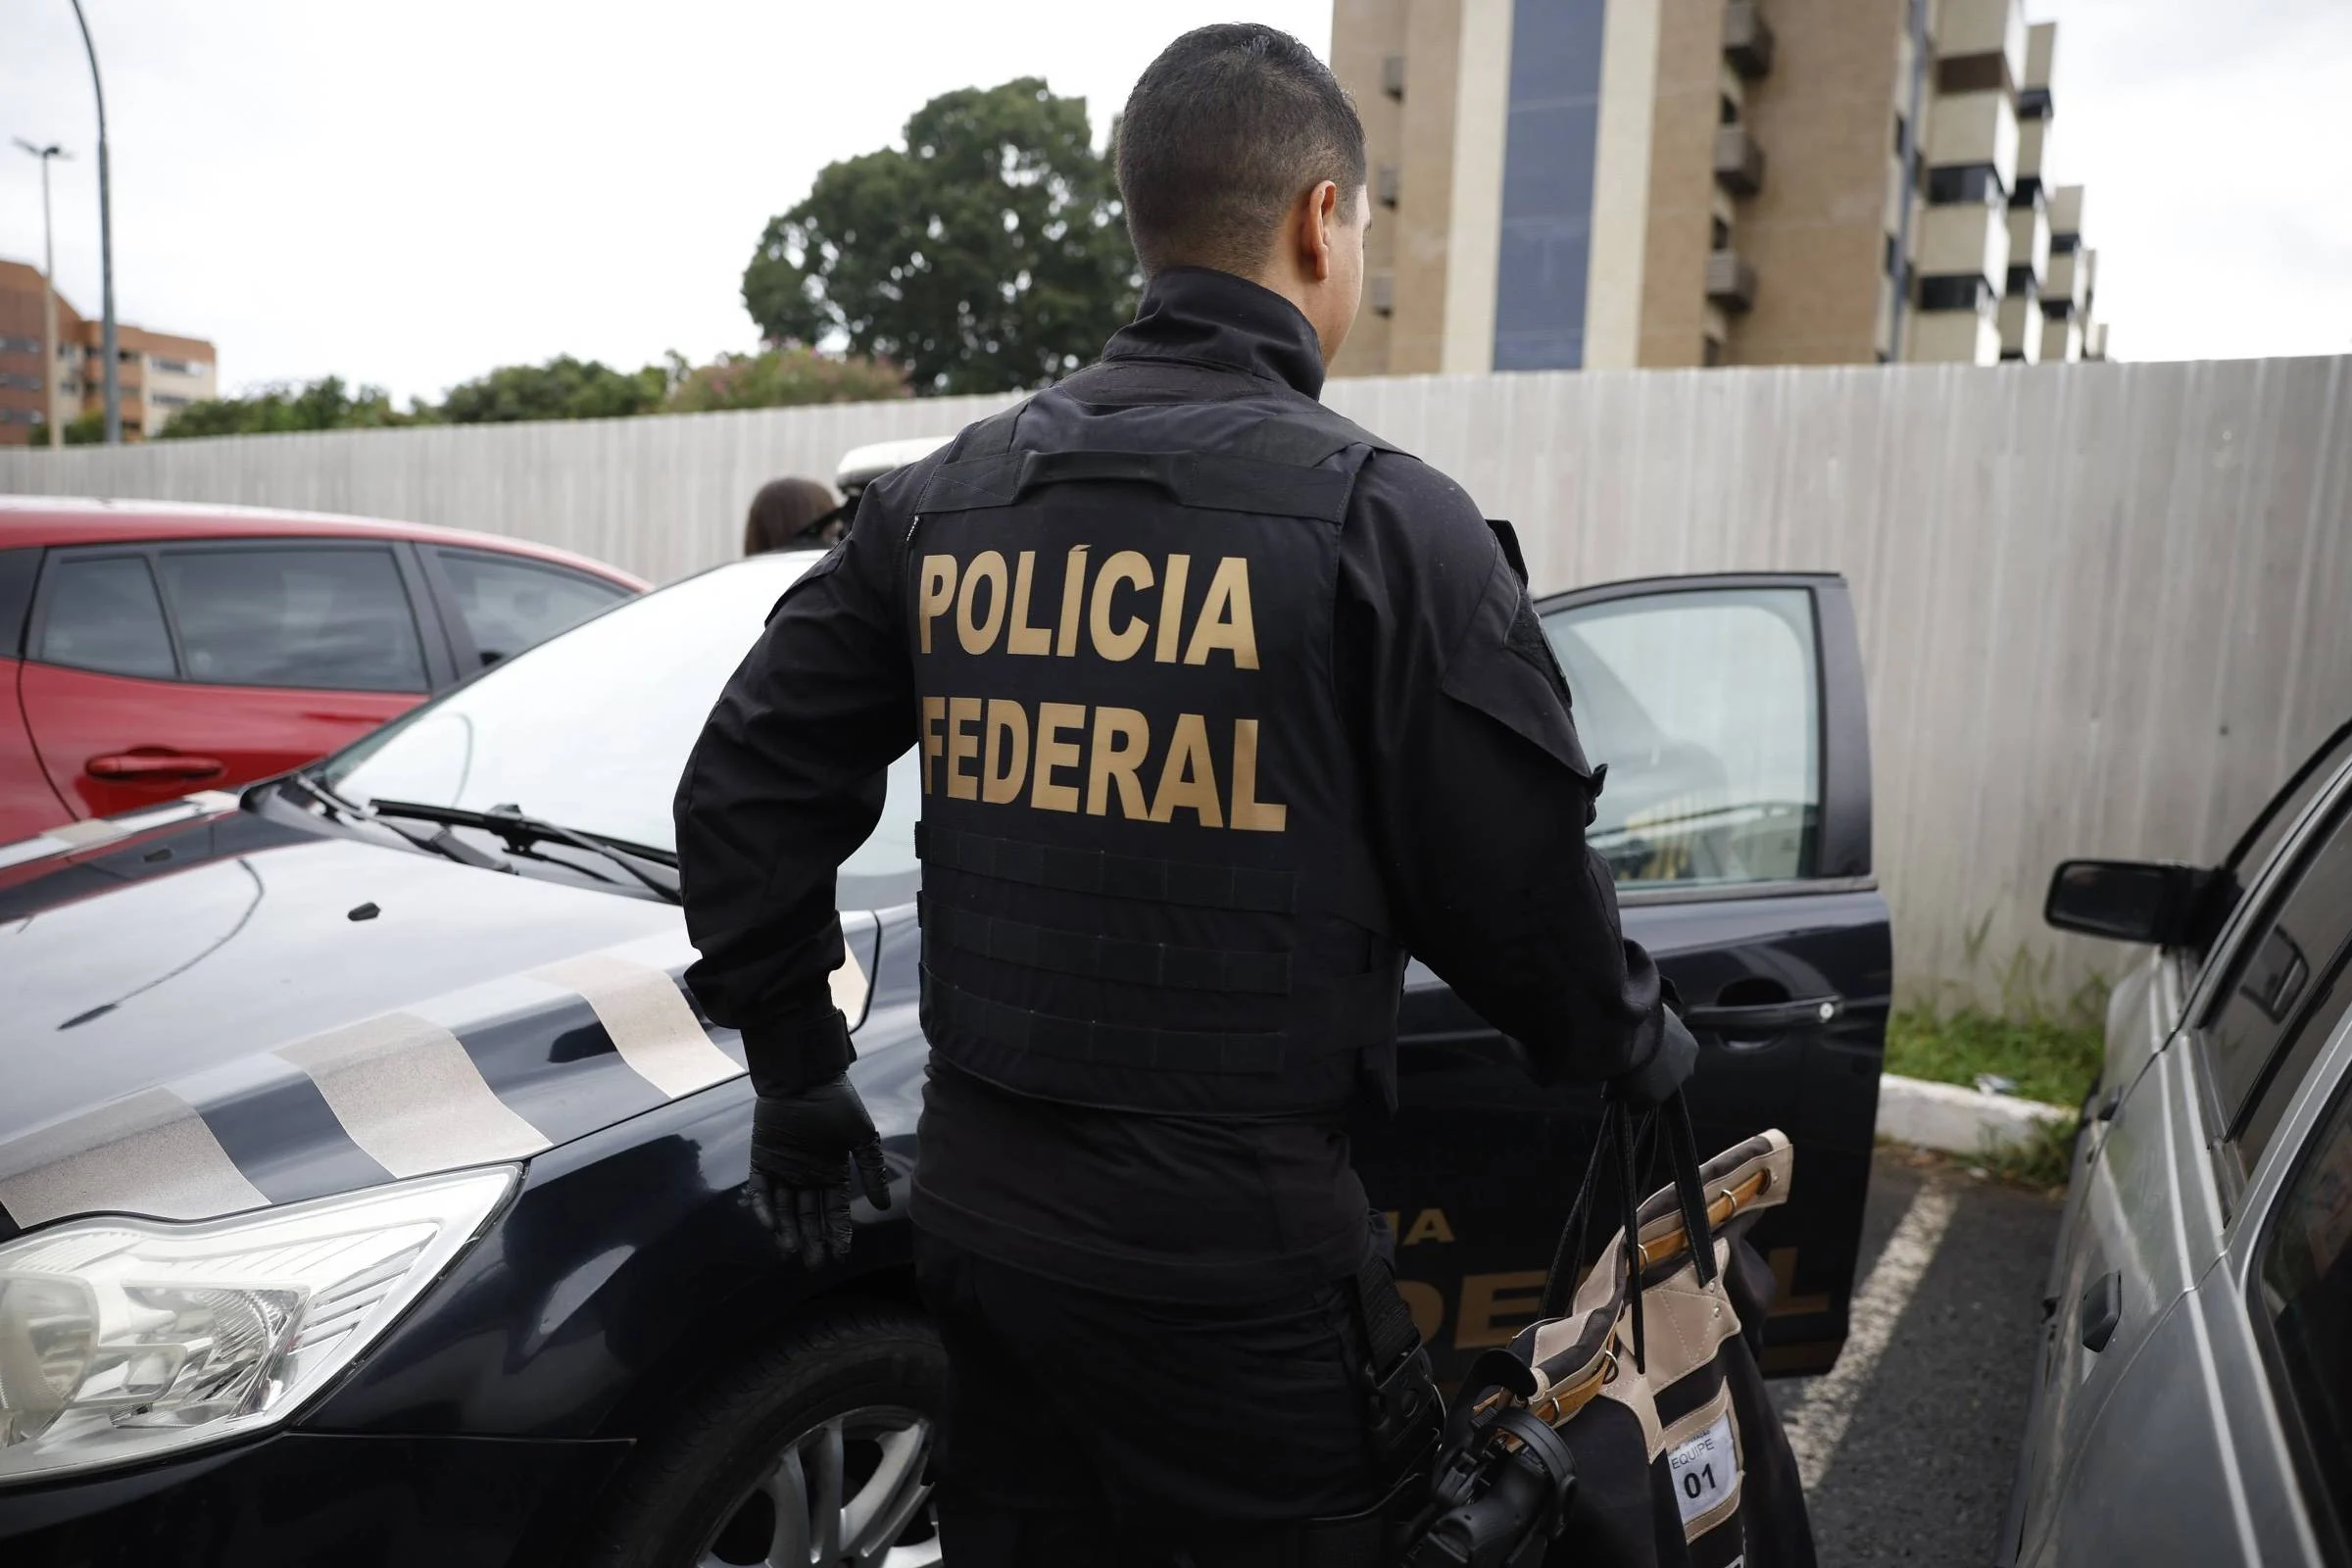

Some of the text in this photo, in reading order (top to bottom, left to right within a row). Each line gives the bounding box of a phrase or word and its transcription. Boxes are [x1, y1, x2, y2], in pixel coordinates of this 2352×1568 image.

[918, 544, 1260, 670] POLÍCIA
[922, 696, 1287, 832] FEDERAL
[1671, 1438, 1715, 1470] EQUIPE
[1684, 1462, 1716, 1499] 01
